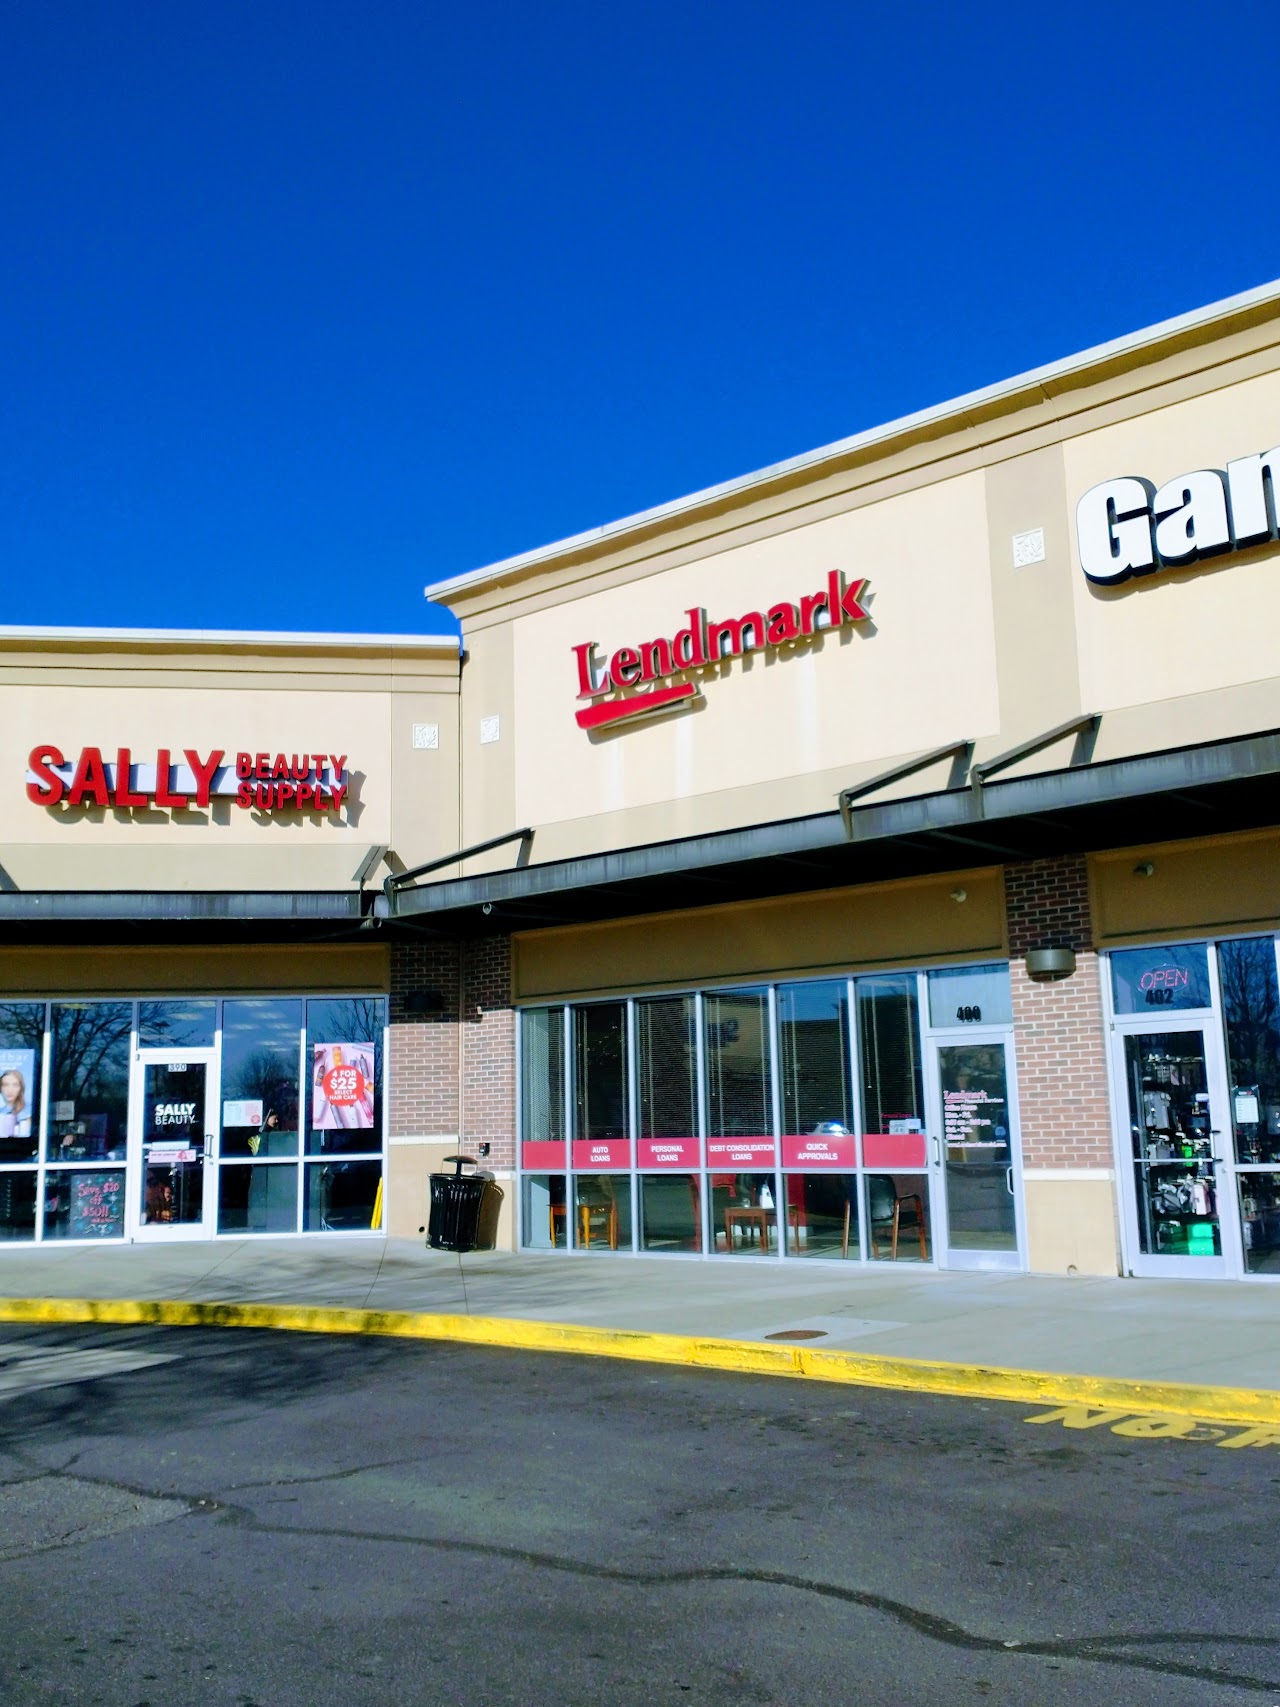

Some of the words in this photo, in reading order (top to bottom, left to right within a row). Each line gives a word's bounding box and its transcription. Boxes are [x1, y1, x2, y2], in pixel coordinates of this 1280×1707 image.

[571, 568, 873, 700] Lendmark
[235, 752, 348, 781] BEAUTY
[26, 745, 225, 808] SALLY
[235, 783, 348, 811] SUPPLY
[1140, 968, 1188, 989] OPEN
[1145, 988, 1174, 1005] 402
[956, 1005, 982, 1023] 400
[169, 1063, 186, 1072] 390
[332, 1070, 338, 1078] 4
[340, 1070, 357, 1078] FOR
[330, 1077, 357, 1090] $25
[155, 1103, 196, 1116] SALLY
[592, 1146, 609, 1154] AUTO
[651, 1145, 684, 1153] PERSONAL
[726, 1144, 774, 1152] CONSOLIDATION
[806, 1143, 828, 1151] QUICK
[656, 1154, 679, 1162] LOANS
[731, 1153, 752, 1161] LOANS
[797, 1152, 838, 1160] APPROVALS
[103, 1182, 119, 1193] $20
[1023, 1405, 1197, 1438] NO
